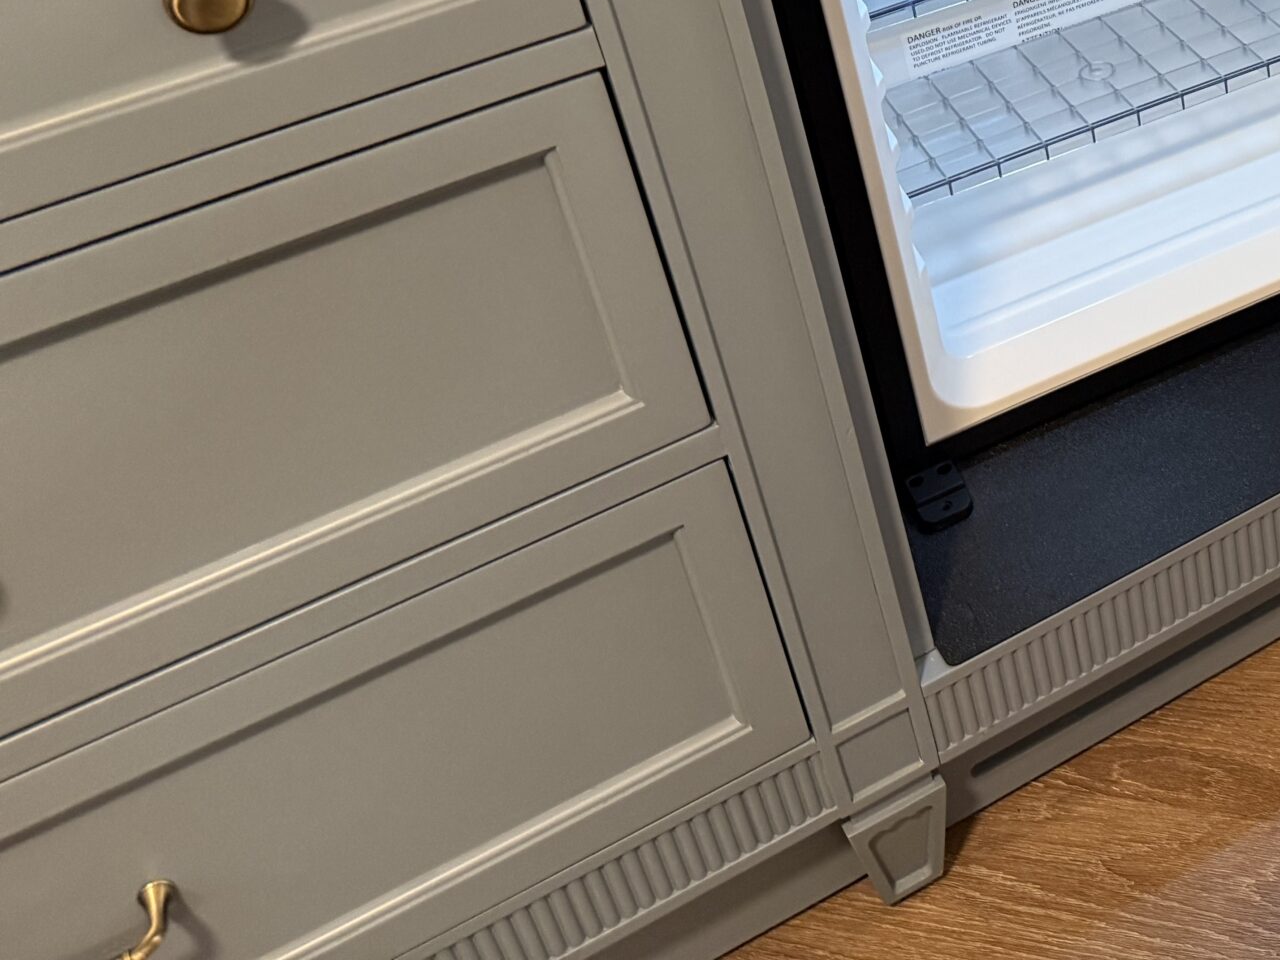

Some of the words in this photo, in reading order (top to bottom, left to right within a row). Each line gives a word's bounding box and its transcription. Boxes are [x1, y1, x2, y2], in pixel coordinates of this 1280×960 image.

[907, 27, 941, 44] DANGER
[941, 25, 973, 40] FLAMMABLE
[973, 14, 1008, 28] REFRIGERANT
[957, 27, 991, 41] MECHANICAL
[991, 18, 1012, 29] DEVICES
[994, 27, 1006, 35] NOT
[913, 56, 941, 68] PUNCTURE
[942, 44, 976, 58] REFRIGERANT
